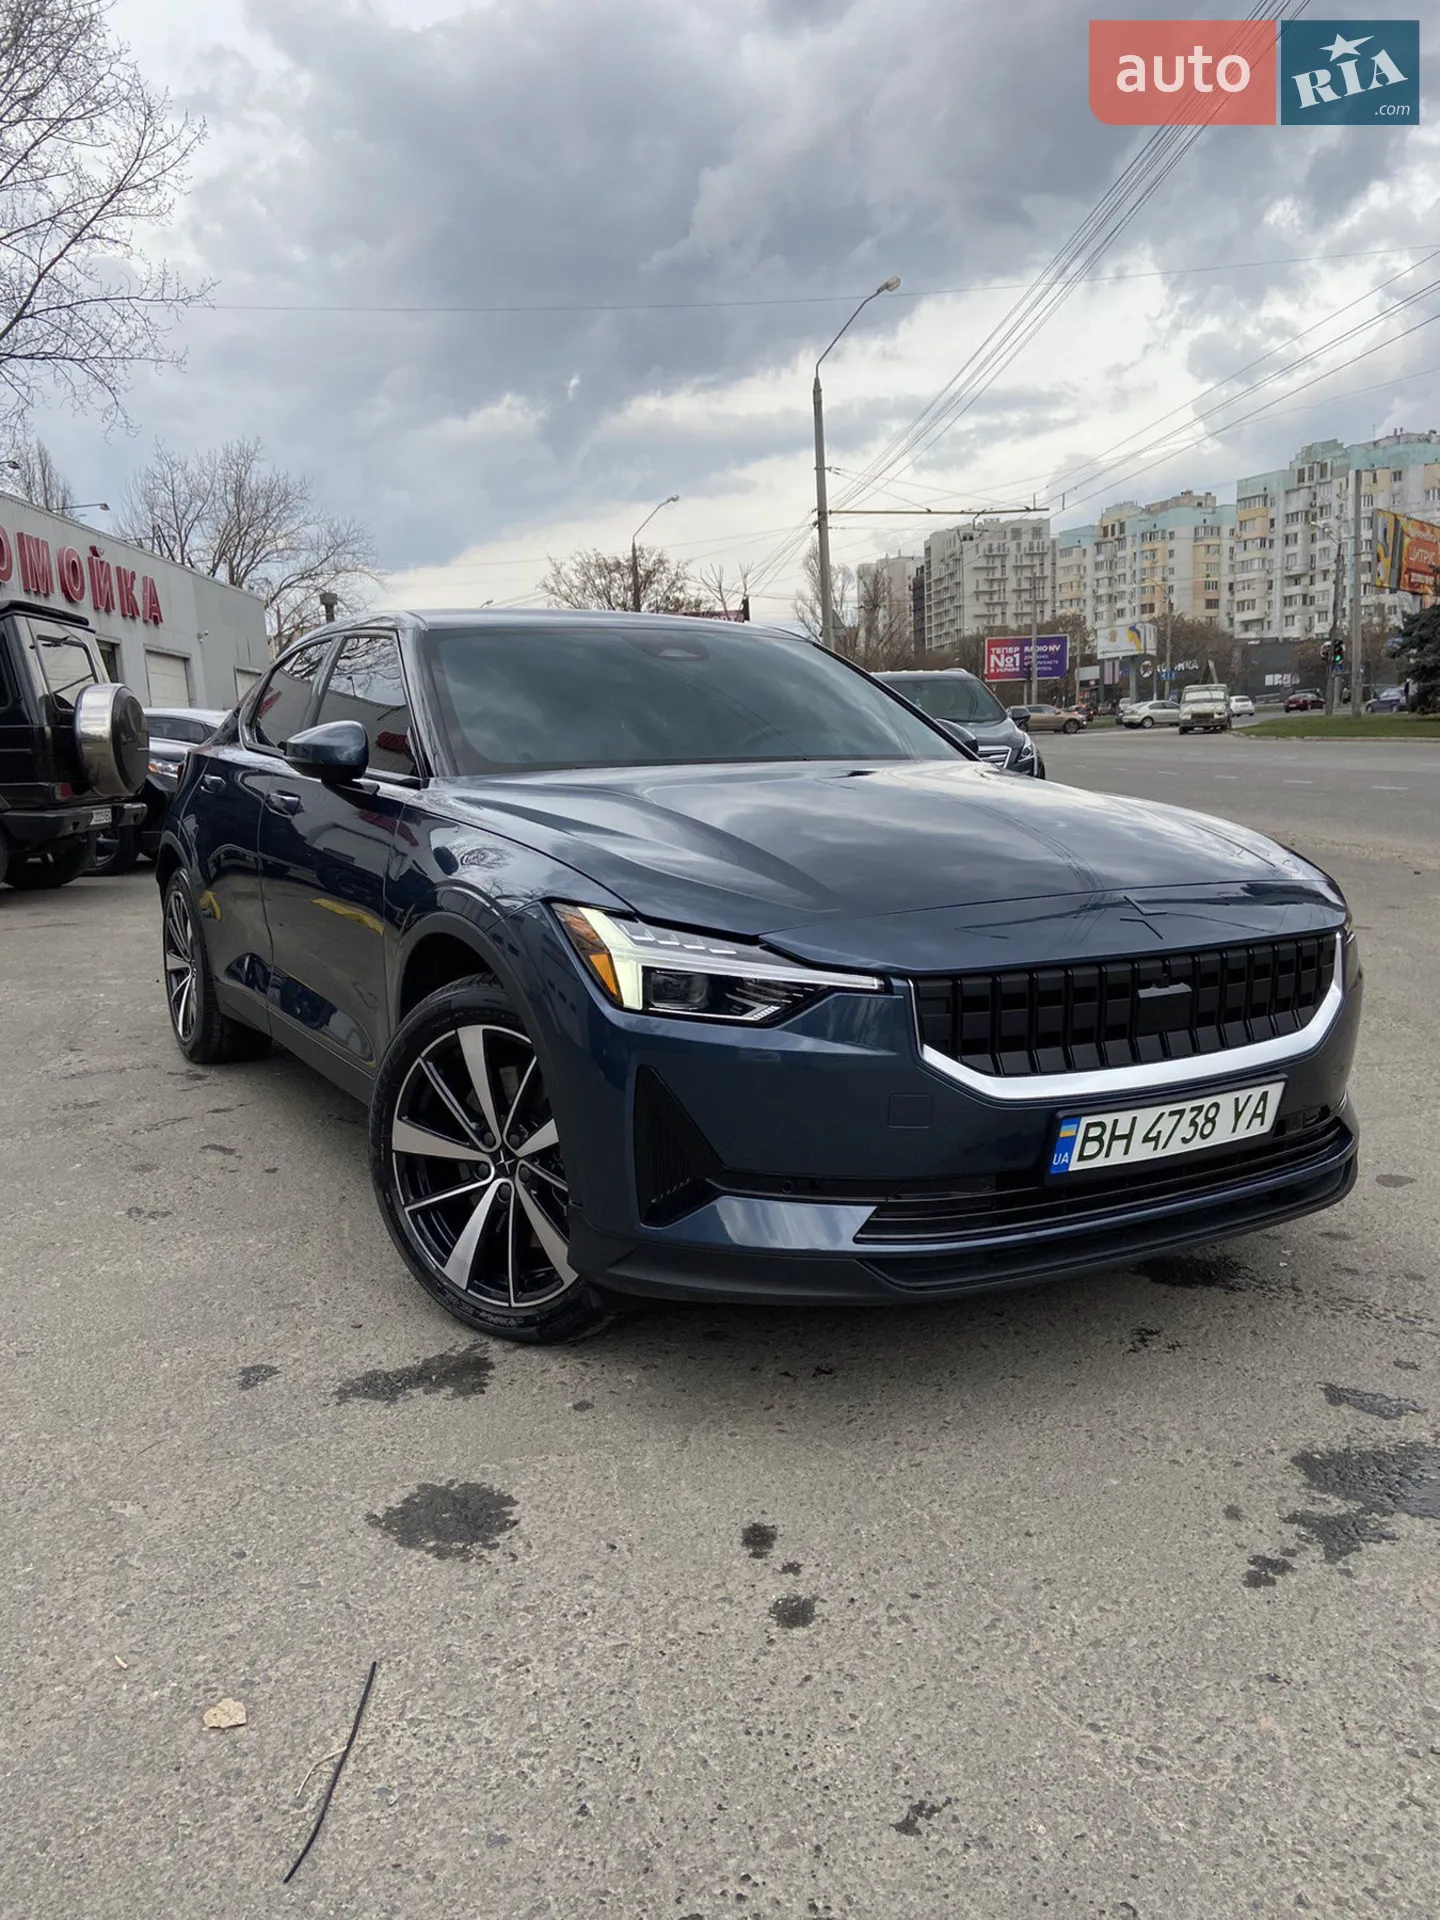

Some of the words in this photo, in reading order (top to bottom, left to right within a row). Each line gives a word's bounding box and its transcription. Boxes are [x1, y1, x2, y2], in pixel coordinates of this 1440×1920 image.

[990, 646, 1020, 655] ТЕПЕР
[1077, 1116, 1138, 1162] BH
[1141, 1101, 1221, 1152] 4738
[1231, 1090, 1268, 1134] YA
[1052, 1152, 1069, 1166] UA
